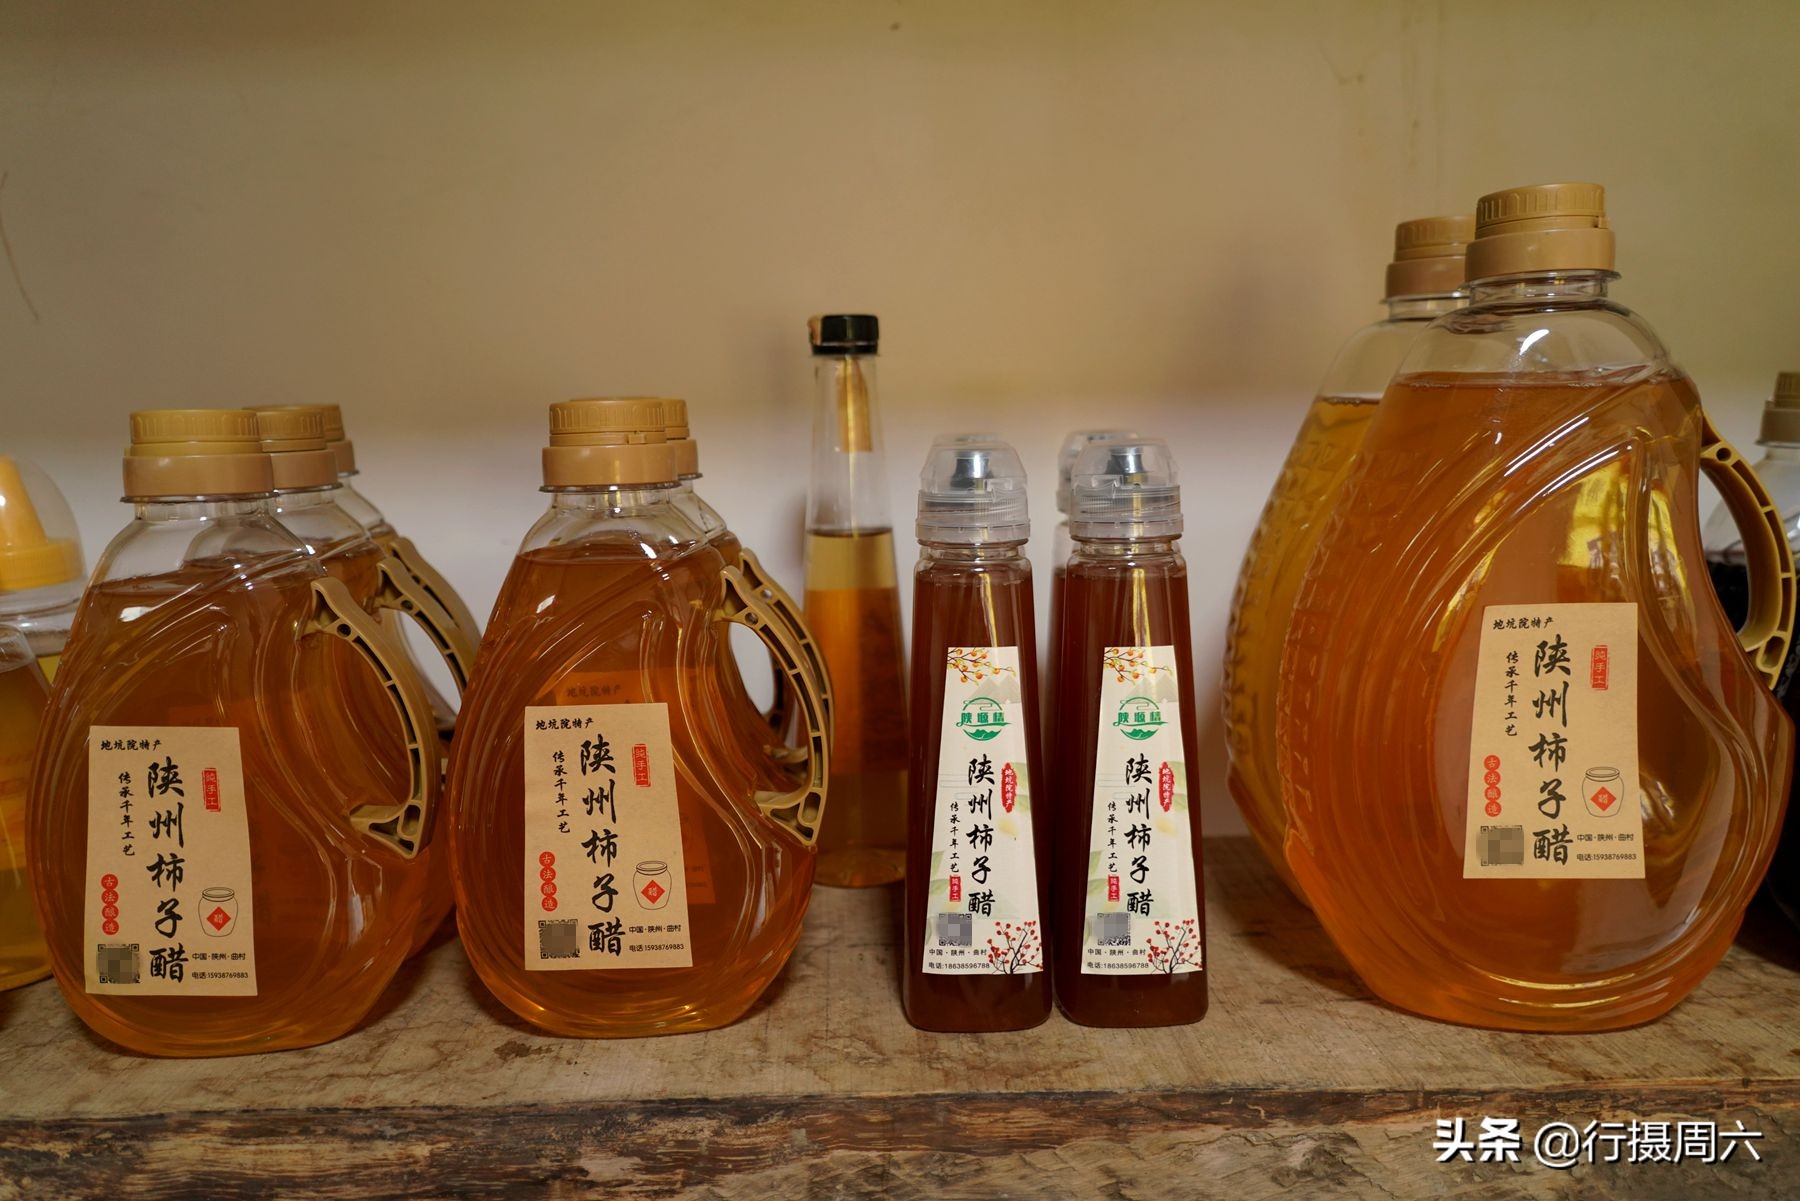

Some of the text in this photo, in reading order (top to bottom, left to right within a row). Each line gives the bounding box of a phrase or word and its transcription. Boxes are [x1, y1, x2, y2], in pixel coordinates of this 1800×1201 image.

[1492, 617, 1555, 630] 地坑院特产
[535, 717, 595, 730] 地坑院特产
[1504, 650, 1520, 736] 传承千年工艺
[100, 739, 163, 751] 地坑院特产
[1528, 633, 1574, 866] 陕州柿子醋
[119, 771, 135, 856] 传承千年工艺
[552, 751, 571, 833] 传承千年工艺
[1485, 756, 1501, 816] 古法酿造
[146, 756, 189, 983] 陕州柿子醋
[580, 733, 626, 957] 陕州柿子醋
[949, 801, 960, 873] 传承千年工艺
[966, 753, 996, 917] 陕州柿子醋
[1107, 801, 1118, 873] 传承千年工艺
[1124, 753, 1154, 917] 陕州柿子醋
[103, 875, 118, 934] 古法酿造
[540, 853, 557, 910] 古法酿造
